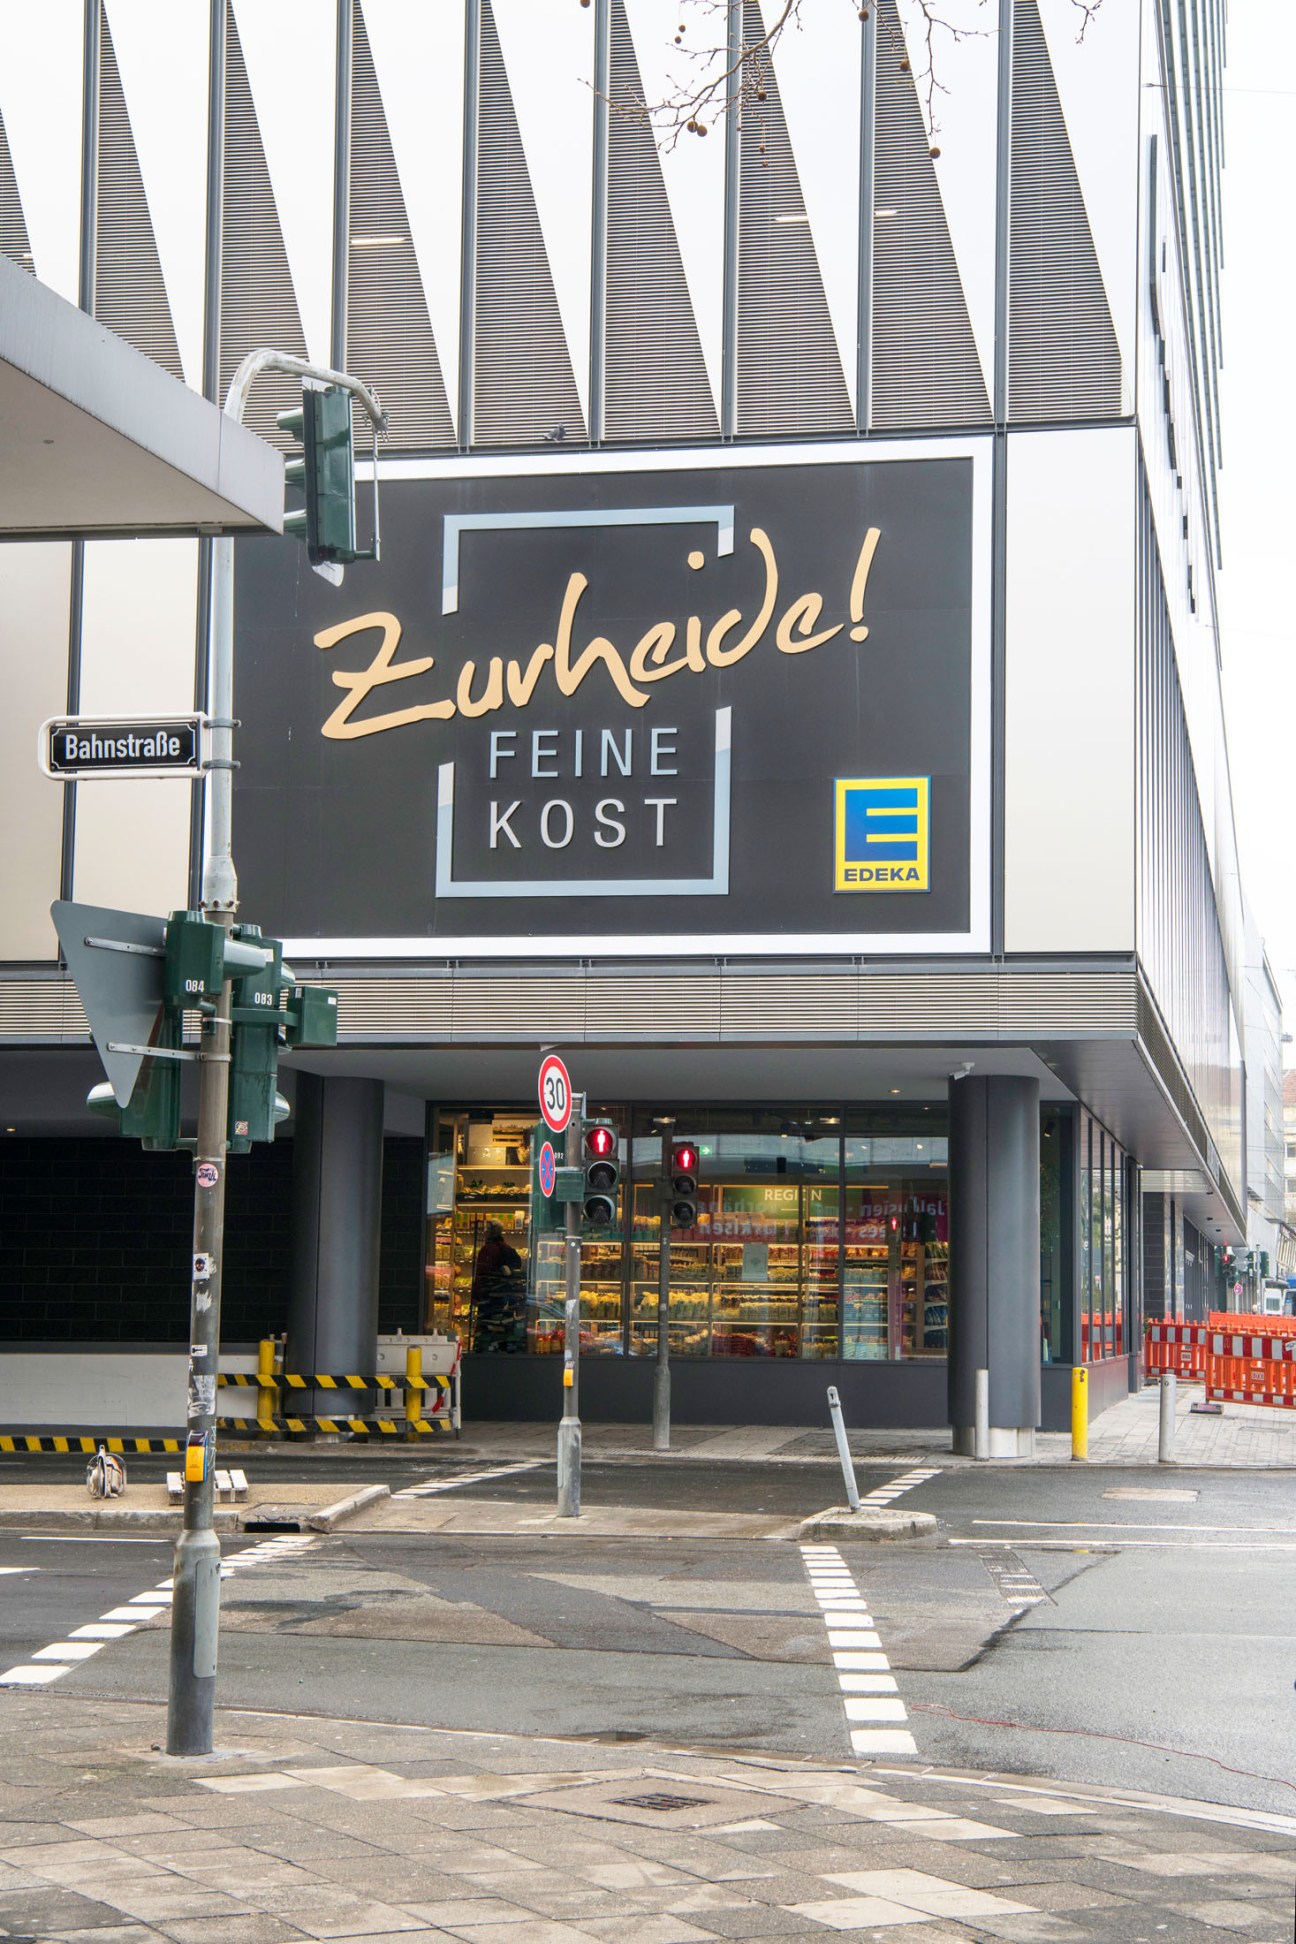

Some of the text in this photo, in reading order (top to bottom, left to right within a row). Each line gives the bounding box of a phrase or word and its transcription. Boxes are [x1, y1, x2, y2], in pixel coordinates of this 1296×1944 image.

[313, 527, 881, 740] Zurheide!
[65, 731, 181, 760] Bahnstraße
[489, 727, 678, 778] FEINE
[489, 797, 678, 849] KOST
[844, 867, 920, 882] EDEKA
[185, 979, 205, 993] 084
[254, 992, 273, 1006] 083
[545, 1077, 564, 1110] 30
[764, 1189, 823, 1201] REGIN
